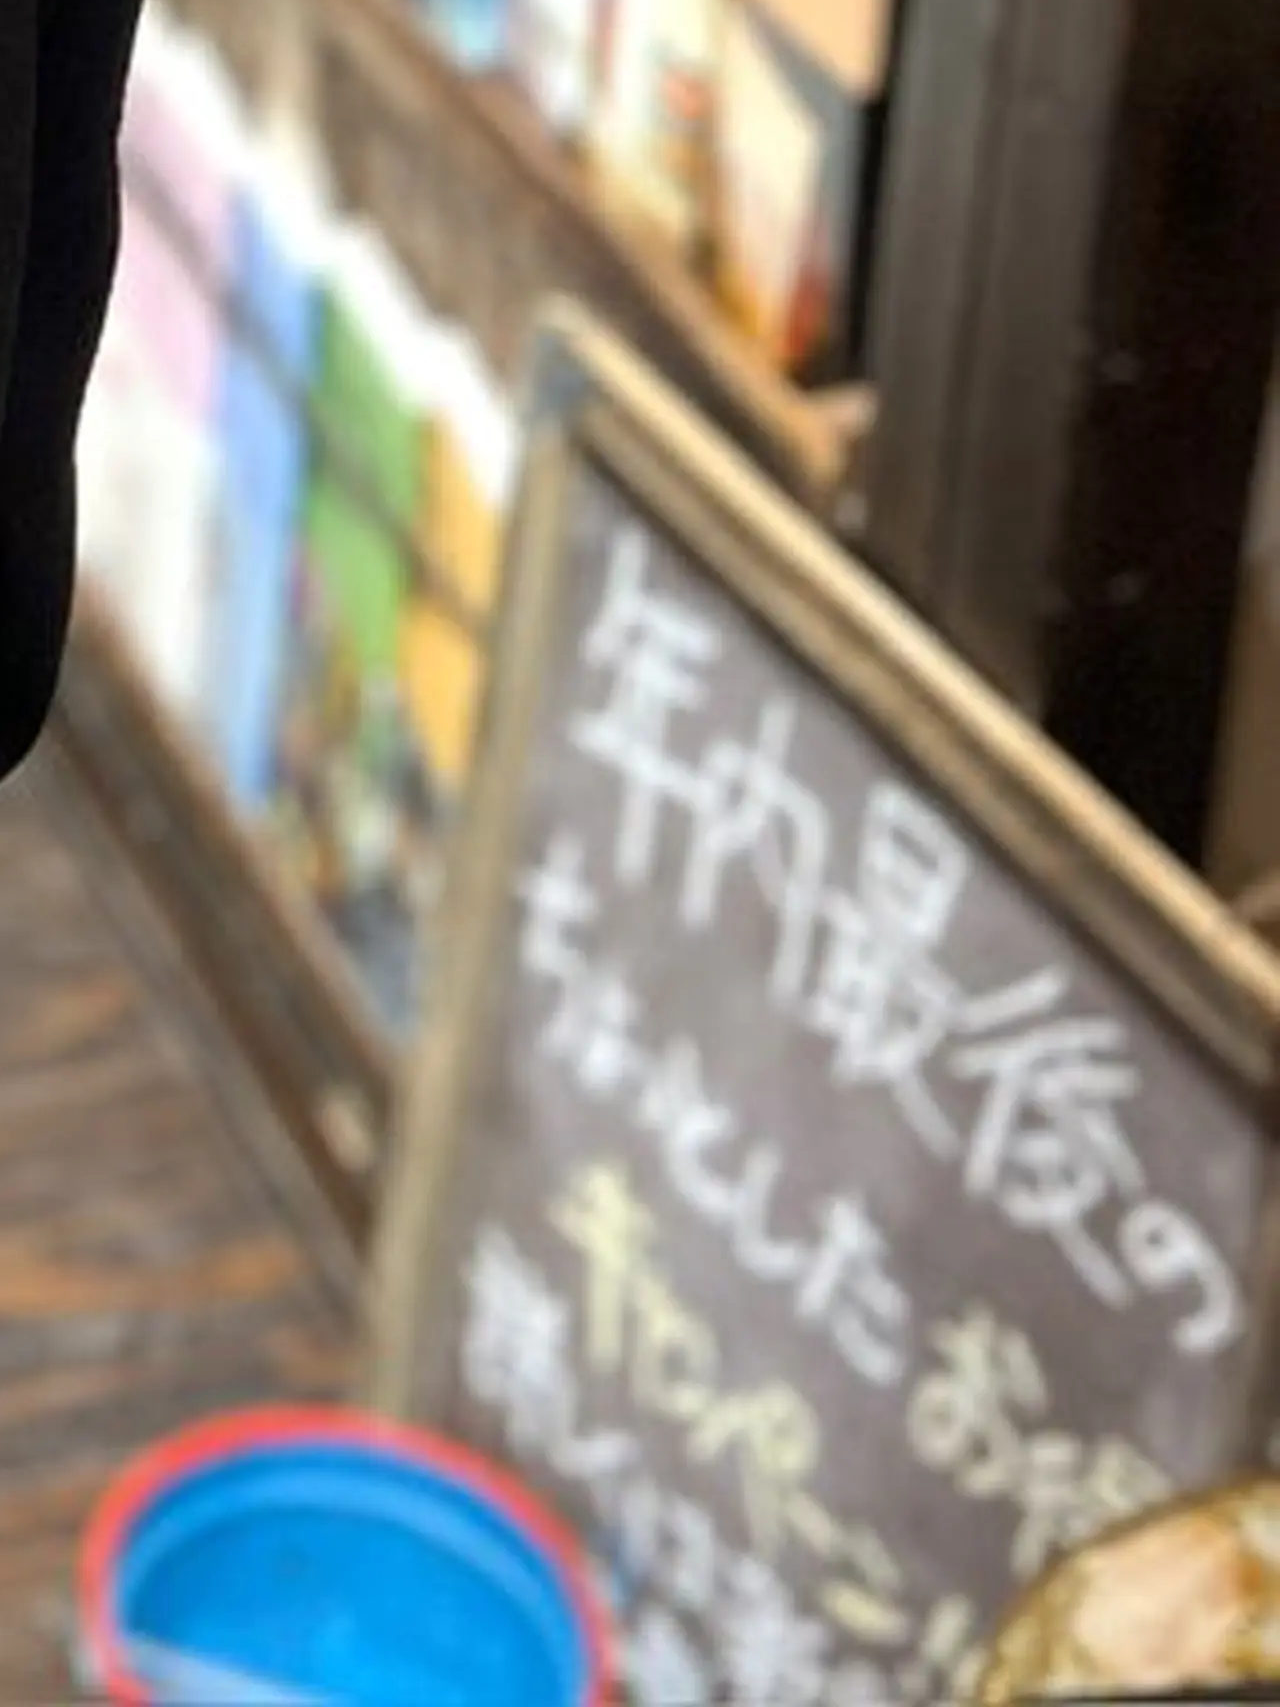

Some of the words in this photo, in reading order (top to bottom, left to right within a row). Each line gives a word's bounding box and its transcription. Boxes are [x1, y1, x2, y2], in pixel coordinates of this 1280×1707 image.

[567, 521, 1239, 1355] 年内最後の
